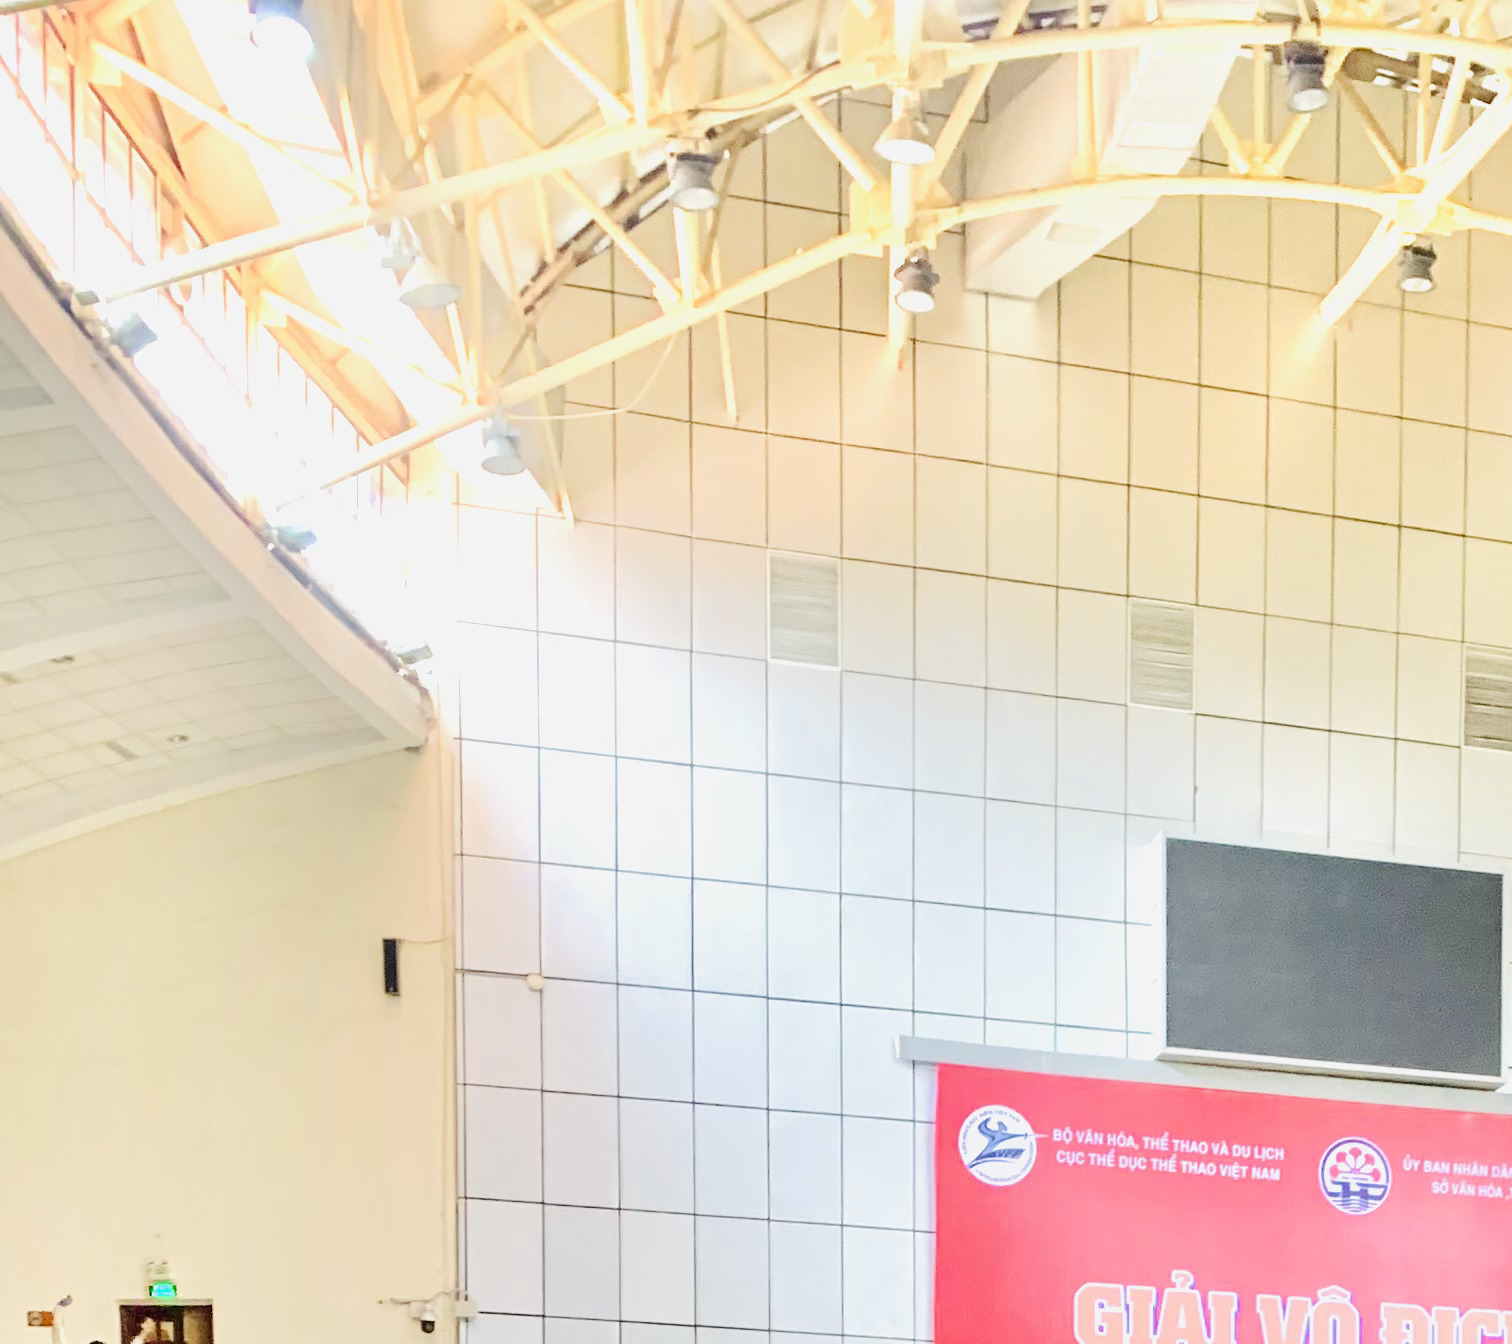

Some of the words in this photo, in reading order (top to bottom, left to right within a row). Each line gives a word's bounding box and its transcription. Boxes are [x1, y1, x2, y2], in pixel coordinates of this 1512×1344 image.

[1053, 1126, 1073, 1144] BỘ
[1107, 1131, 1139, 1150] HÓA,
[1172, 1138, 1209, 1154] THAO
[1211, 1140, 1230, 1156] VÀ
[1232, 1144, 1251, 1158] DU
[1254, 1146, 1285, 1162] LỊCH
[1056, 1149, 1085, 1167] CỤC
[1118, 1155, 1147, 1172] DỤC
[1180, 1160, 1217, 1176] THAO
[1220, 1161, 1249, 1180] VIỆT
[1252, 1166, 1281, 1181] NAM
[1423, 1159, 1451, 1174] BAN
[1453, 1161, 1489, 1178] NHÂN
[1477, 1181, 1503, 1198] HÓA
